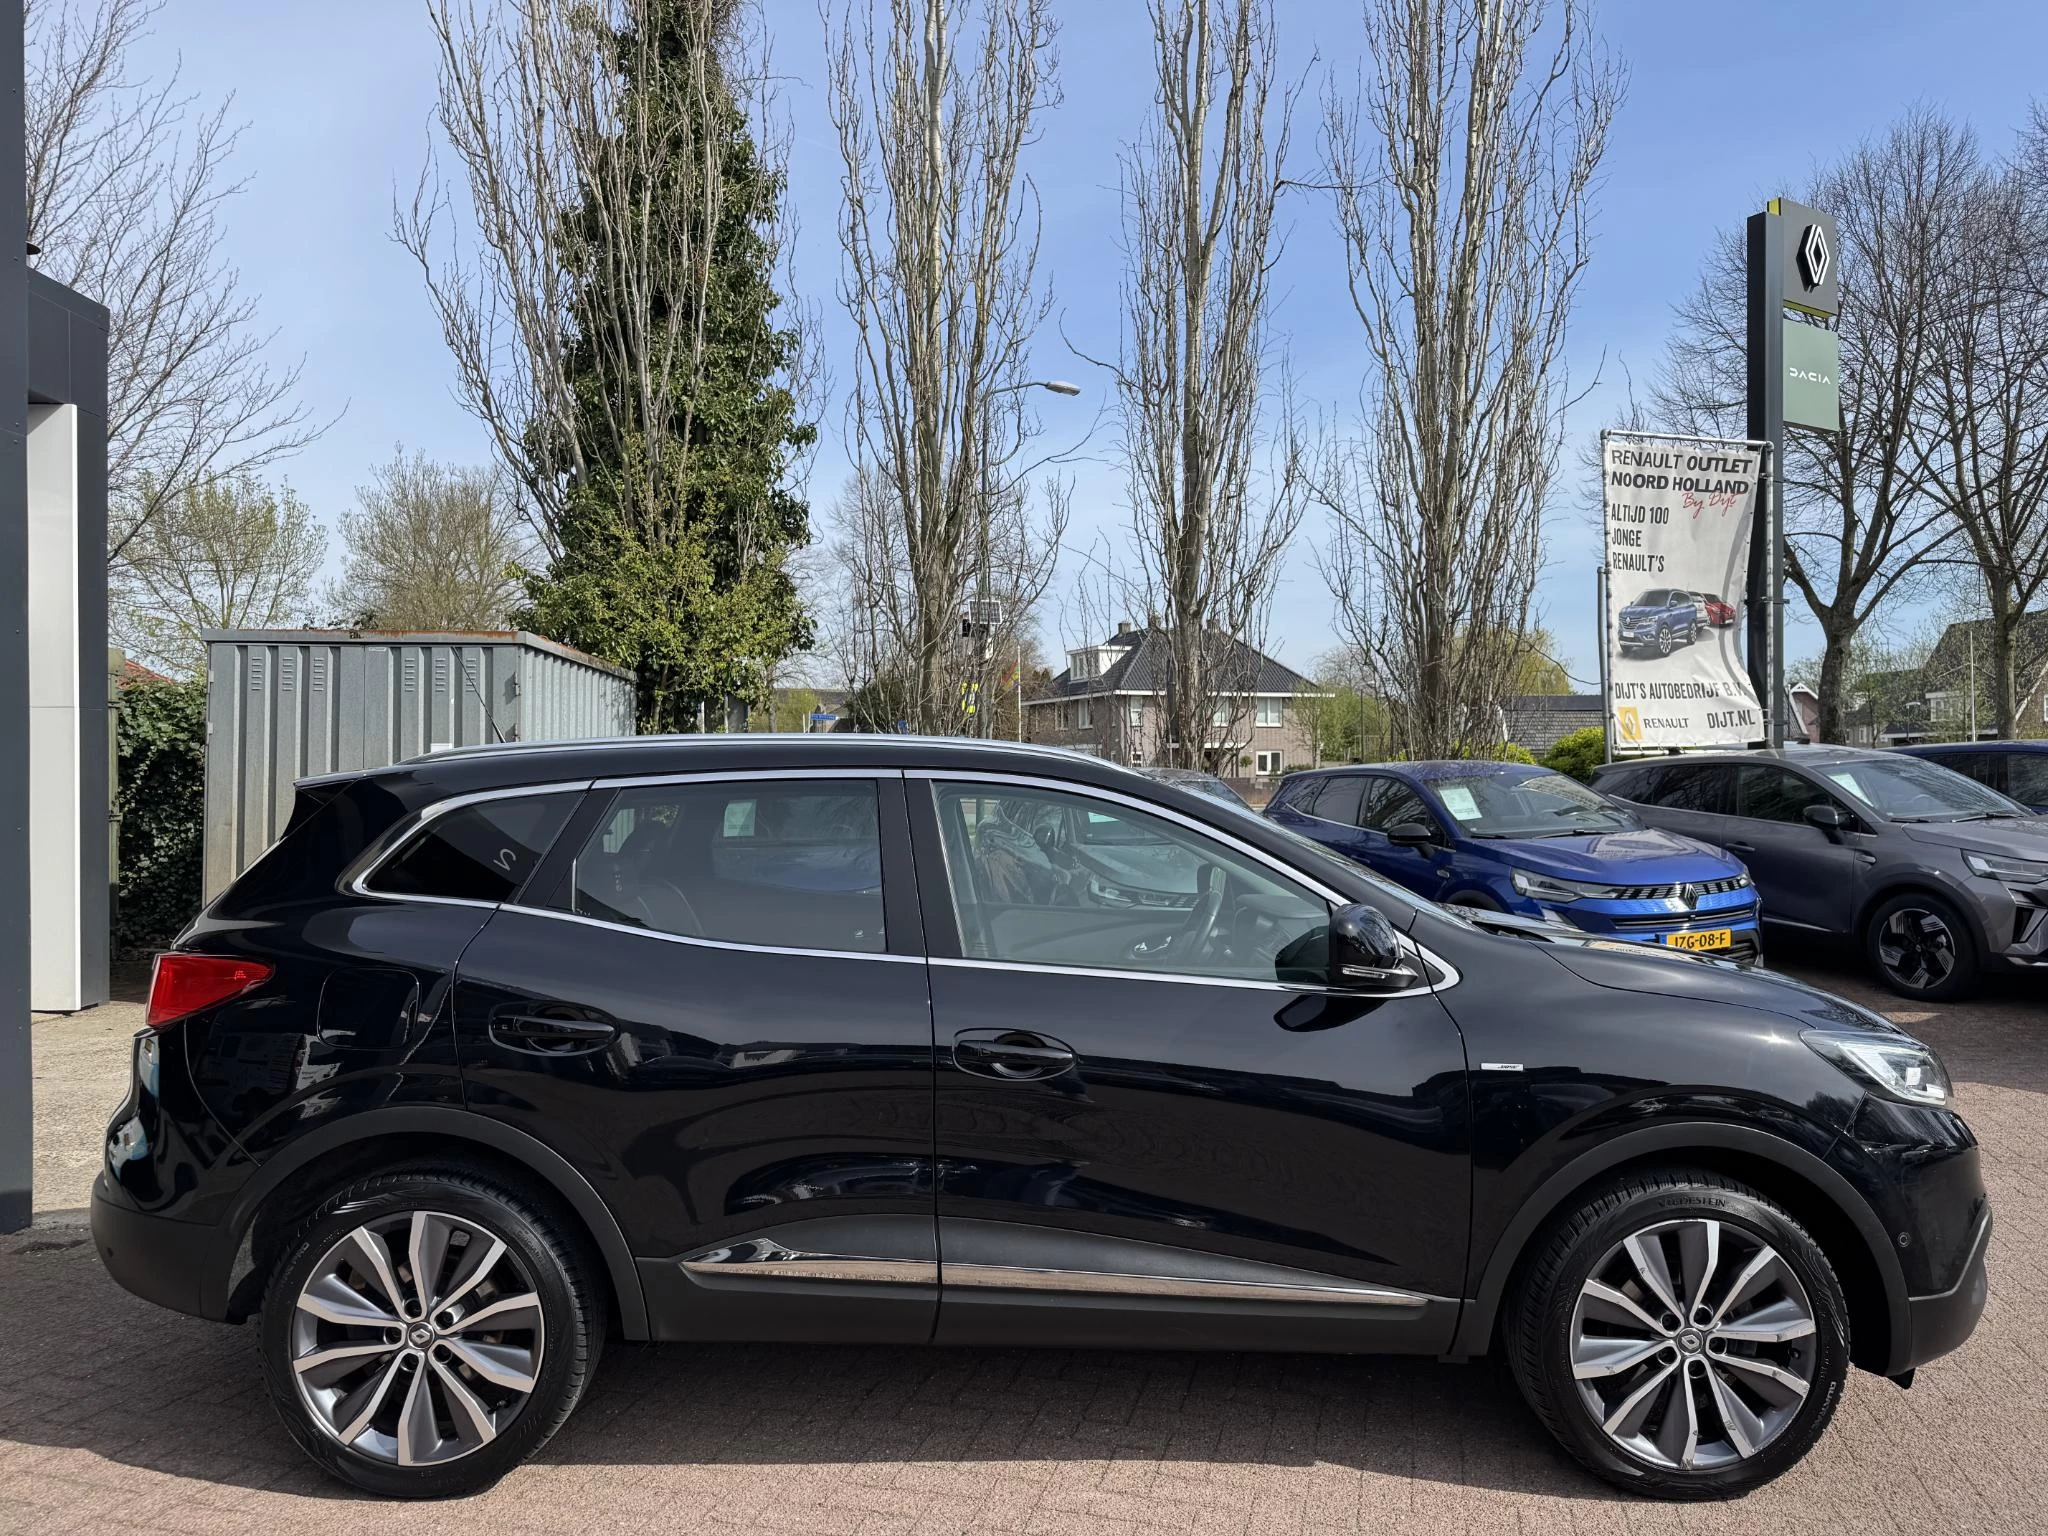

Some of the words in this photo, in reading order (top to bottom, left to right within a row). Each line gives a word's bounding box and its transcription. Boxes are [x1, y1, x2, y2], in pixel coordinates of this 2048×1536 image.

[1789, 367, 1831, 385] DACIA
[1612, 450, 1683, 470] RENAULT
[1687, 455, 1753, 474] OUTLET
[1611, 472, 1669, 489] NOORD
[1672, 477, 1749, 495] HOLLAND
[1611, 503, 1646, 524] ALTIJD
[1649, 506, 1669, 525] 100
[1682, 492, 1704, 519] By
[1612, 528, 1642, 547] JONGE
[1612, 552, 1665, 572] RENAULT'S
[1615, 682, 1646, 700] DIJT'S
[1649, 682, 1720, 700] AUTOBEDRIJF
[1644, 718, 1690, 729] RENAULT
[1707, 709, 1756, 729] DIJT.NL
